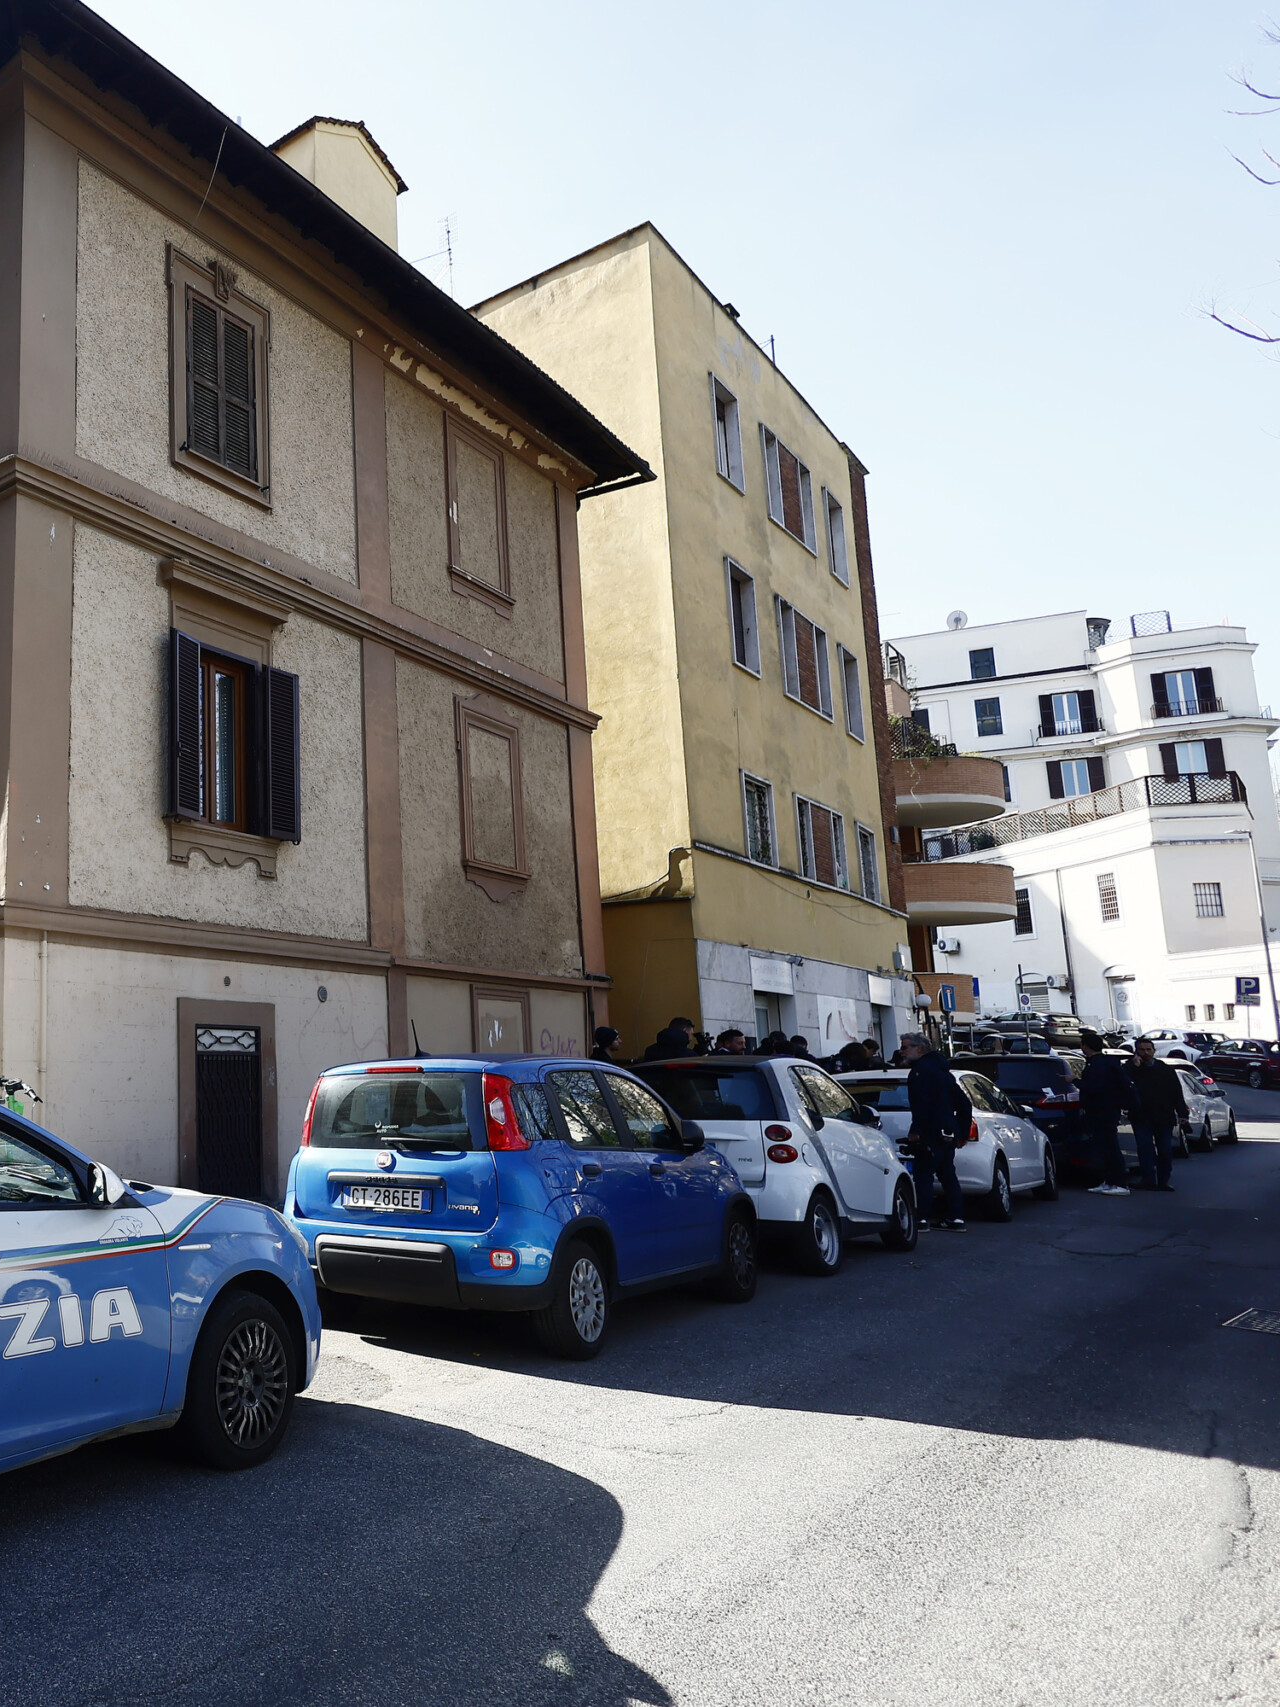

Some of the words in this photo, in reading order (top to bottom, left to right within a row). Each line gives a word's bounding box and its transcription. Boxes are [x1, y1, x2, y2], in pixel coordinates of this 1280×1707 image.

[1240, 978, 1256, 993] P
[351, 1187, 369, 1205] GT
[373, 1188, 420, 1209] 286EE
